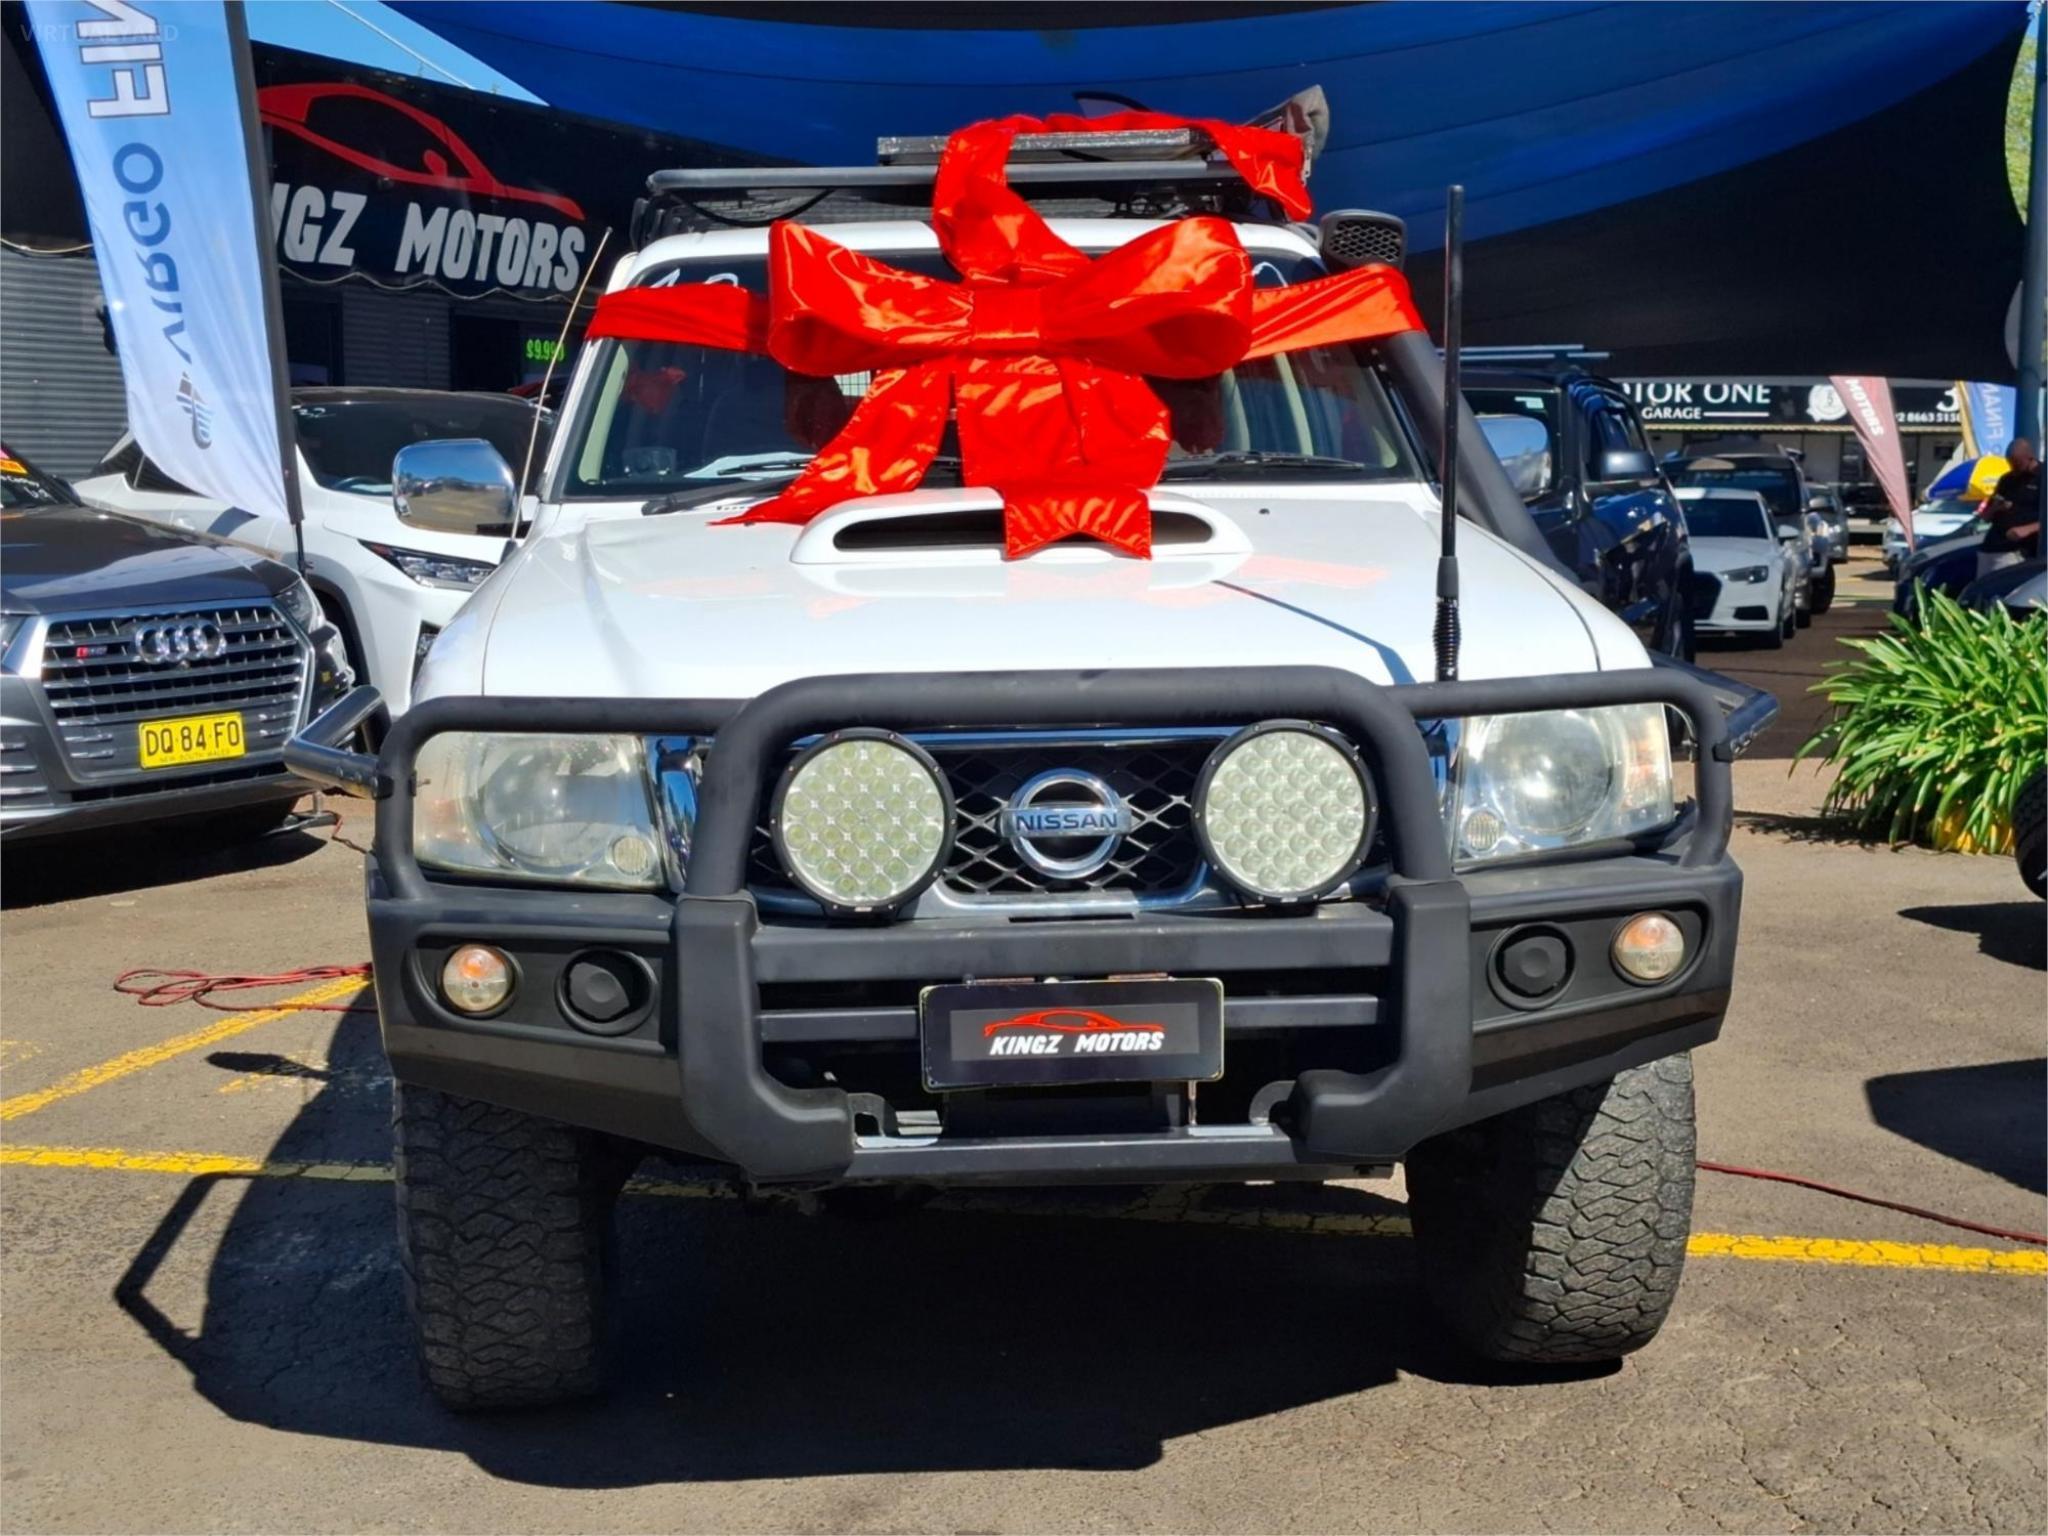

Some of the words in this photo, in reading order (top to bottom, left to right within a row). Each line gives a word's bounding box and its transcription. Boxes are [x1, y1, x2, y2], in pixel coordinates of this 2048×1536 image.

[394, 202, 586, 292] MOTORS
[1703, 383, 1771, 404] ONE
[1641, 407, 1702, 420] GARAGE
[1845, 377, 1885, 437] MOTORS
[1015, 813, 1118, 831] NISSAN
[989, 1034, 1064, 1056] KINGZ
[1073, 1031, 1165, 1053] MOTORS
